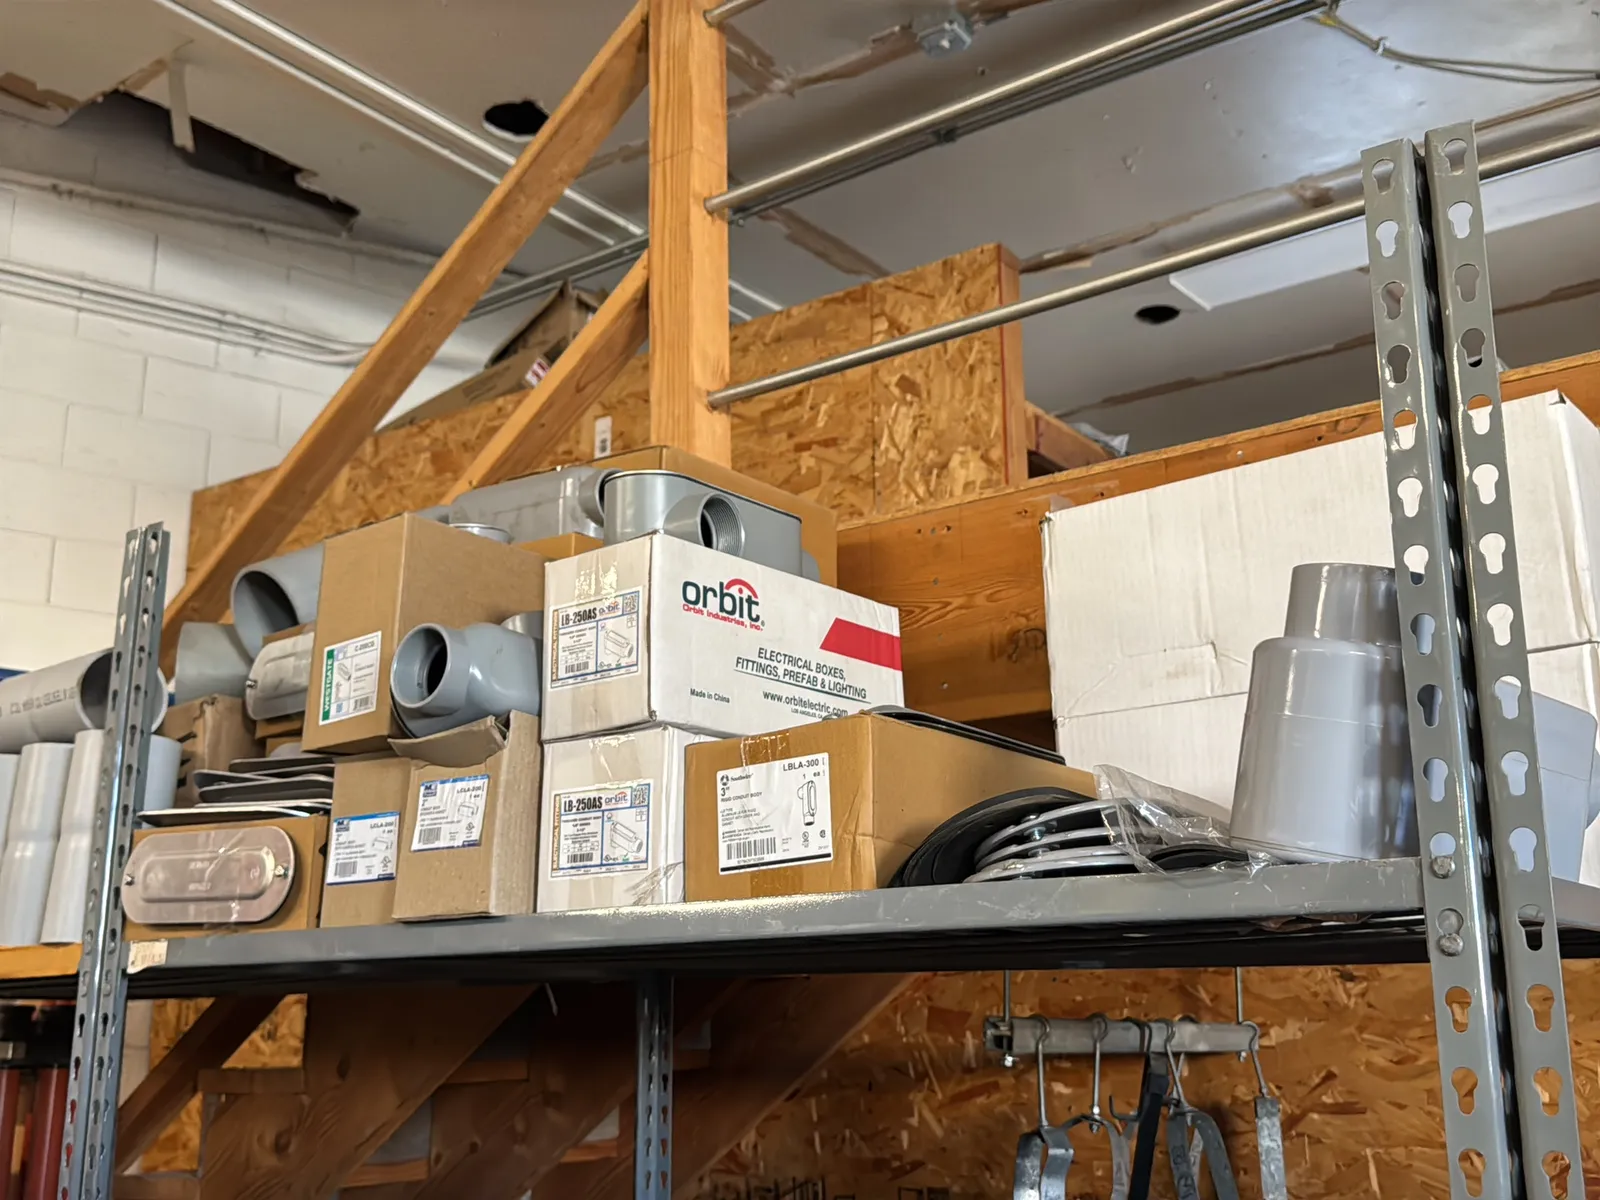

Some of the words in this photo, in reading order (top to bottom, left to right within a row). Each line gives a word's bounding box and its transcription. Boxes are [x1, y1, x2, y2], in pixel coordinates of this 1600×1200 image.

[682, 579, 760, 622] orbit
[561, 607, 597, 626] LB-250AS
[682, 604, 704, 615] Orbit
[707, 610, 747, 628] Industries,
[758, 647, 813, 671] ELECTRICAL
[816, 663, 846, 681] BOXES,
[736, 657, 780, 679] FITTINGS,
[783, 669, 818, 687] PREFAB
[820, 678, 826, 688] &
[828, 681, 867, 699] LIGHTING
[690, 688, 706, 698] Made
[714, 693, 730, 703] China
[763, 690, 848, 717] www.orbitelectric.com
[783, 759, 819, 771] LBLA-300
[563, 796, 603, 812] LB-250AS
[605, 791, 628, 804] orbit
